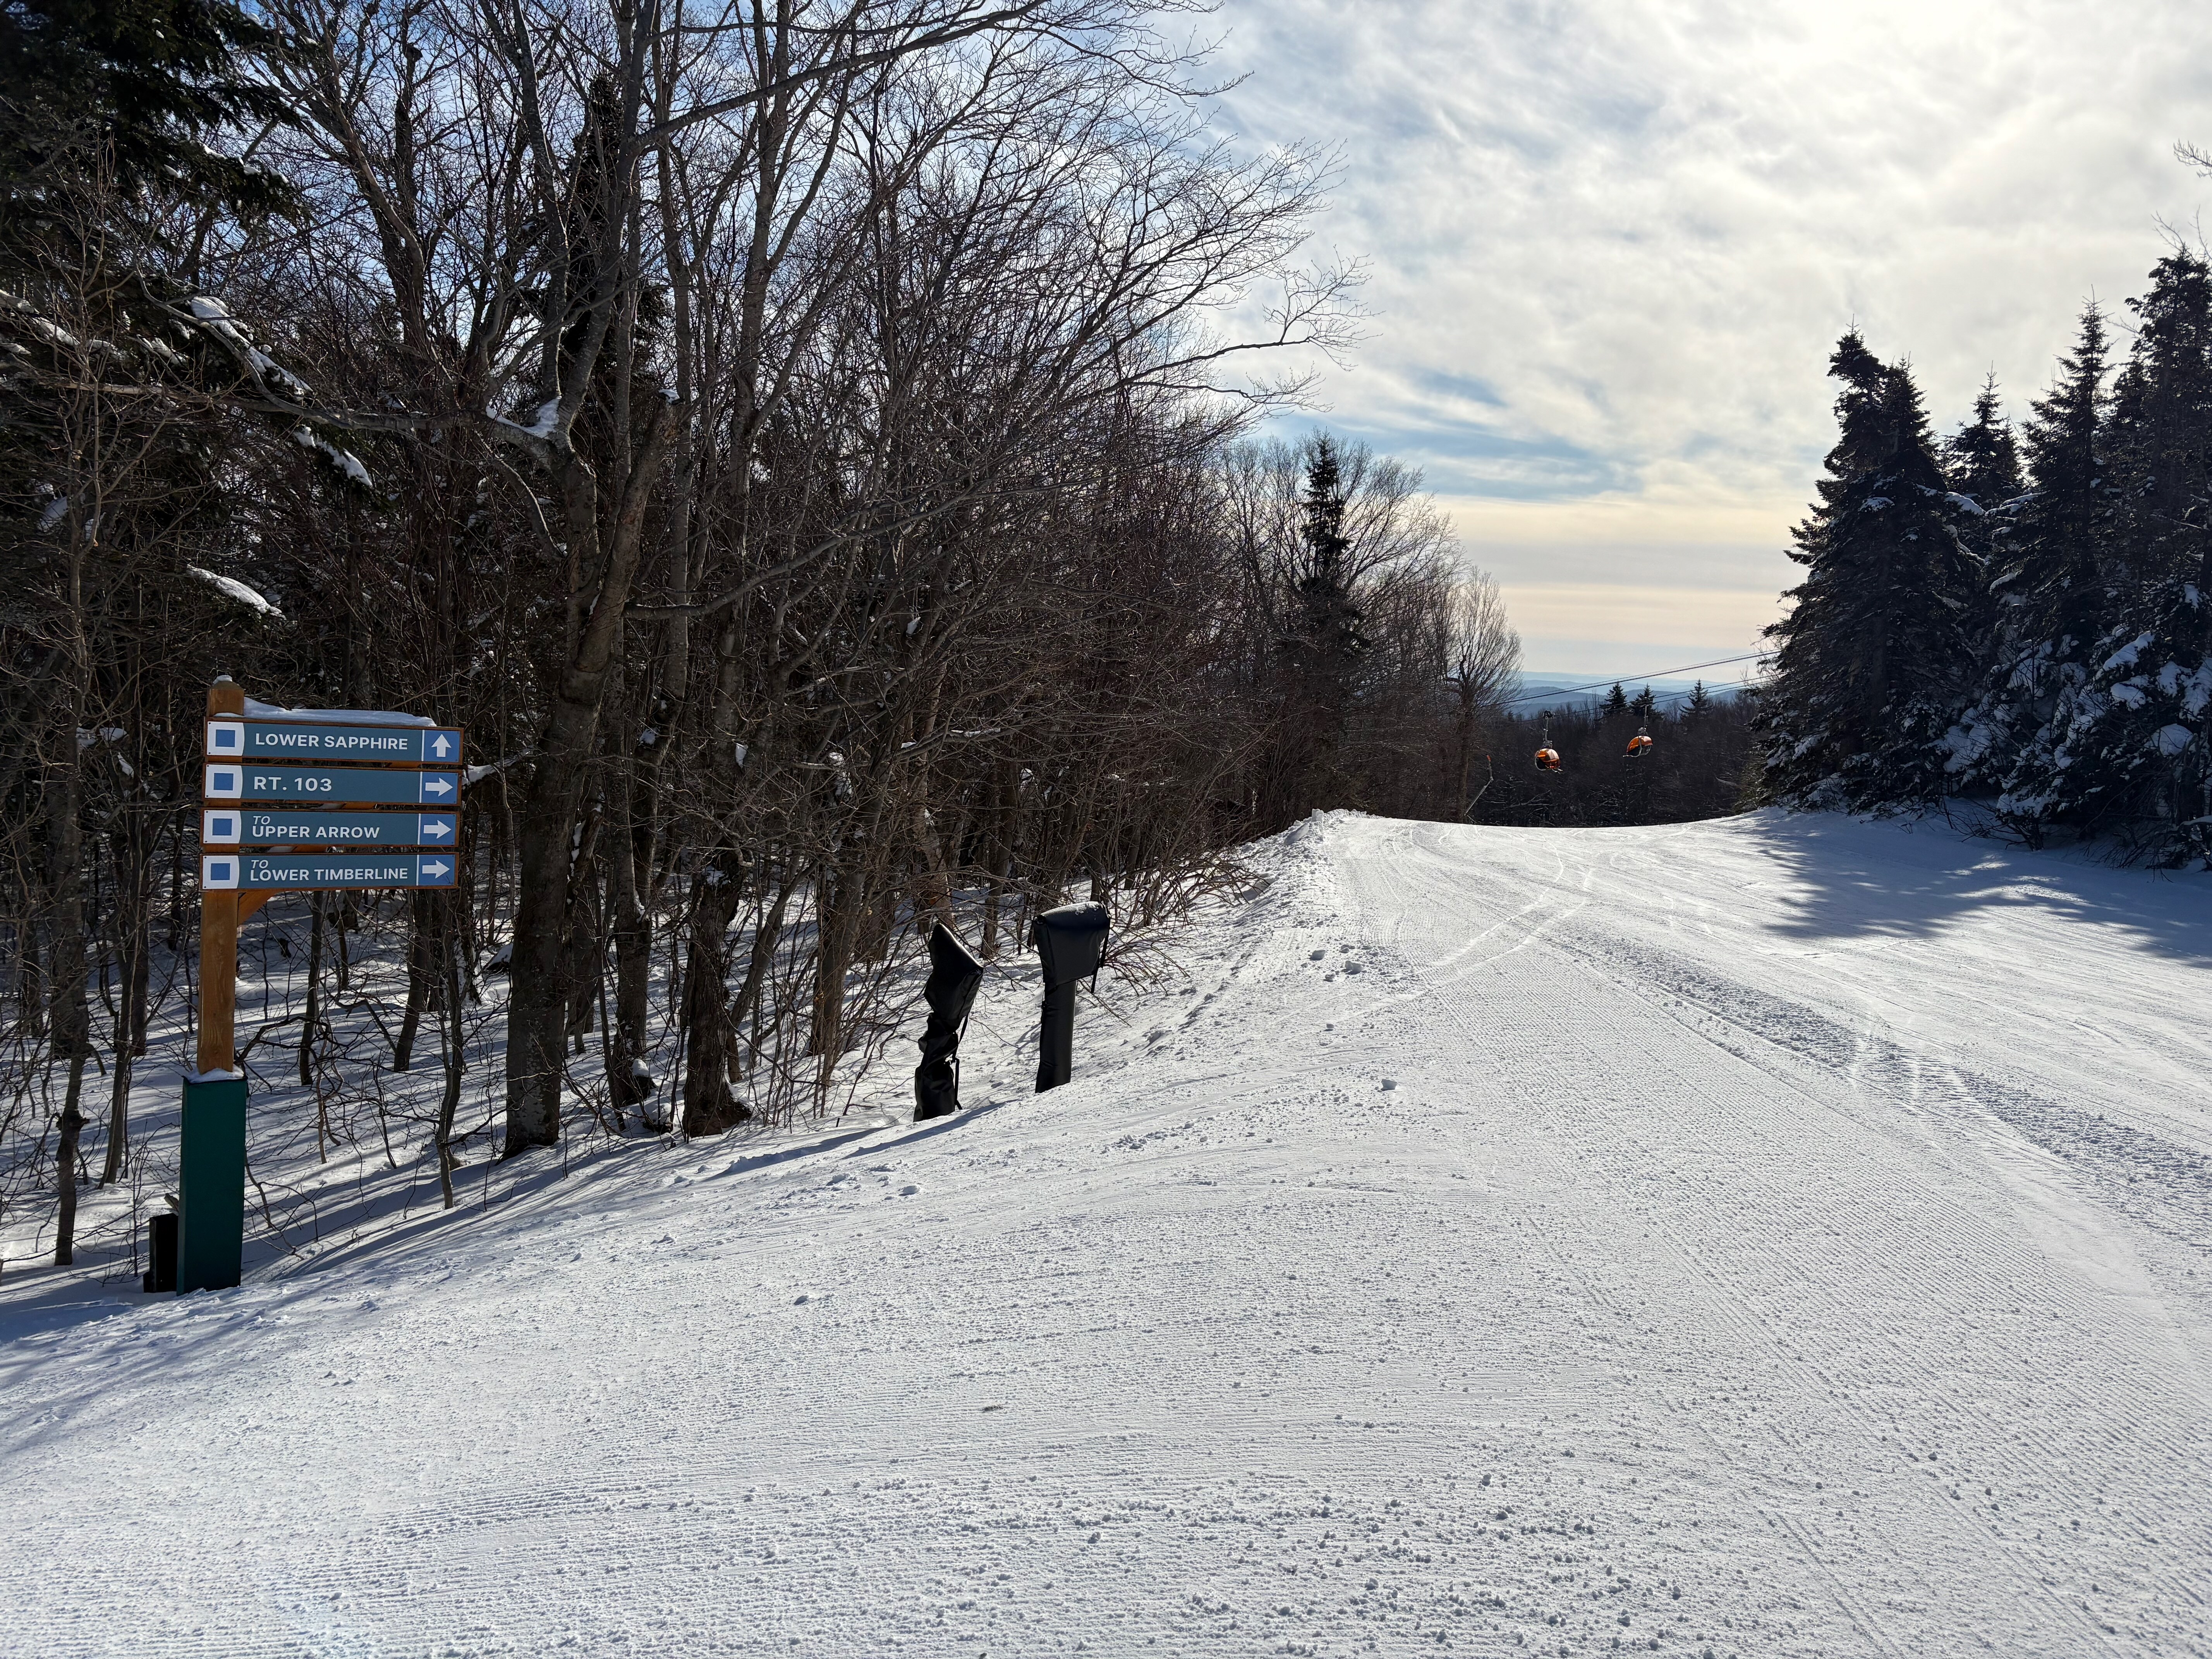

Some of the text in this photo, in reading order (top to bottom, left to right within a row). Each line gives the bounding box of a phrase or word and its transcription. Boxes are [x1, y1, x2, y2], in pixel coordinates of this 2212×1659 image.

[256, 733, 408, 750] LOWER SAPPHIRE
[254, 776, 332, 791] RT. 103
[253, 816, 270, 825] TO
[252, 826, 380, 838] UPPER ARROW
[251, 860, 268, 869] TO
[250, 868, 408, 881] LOWER TIMBERLINE
